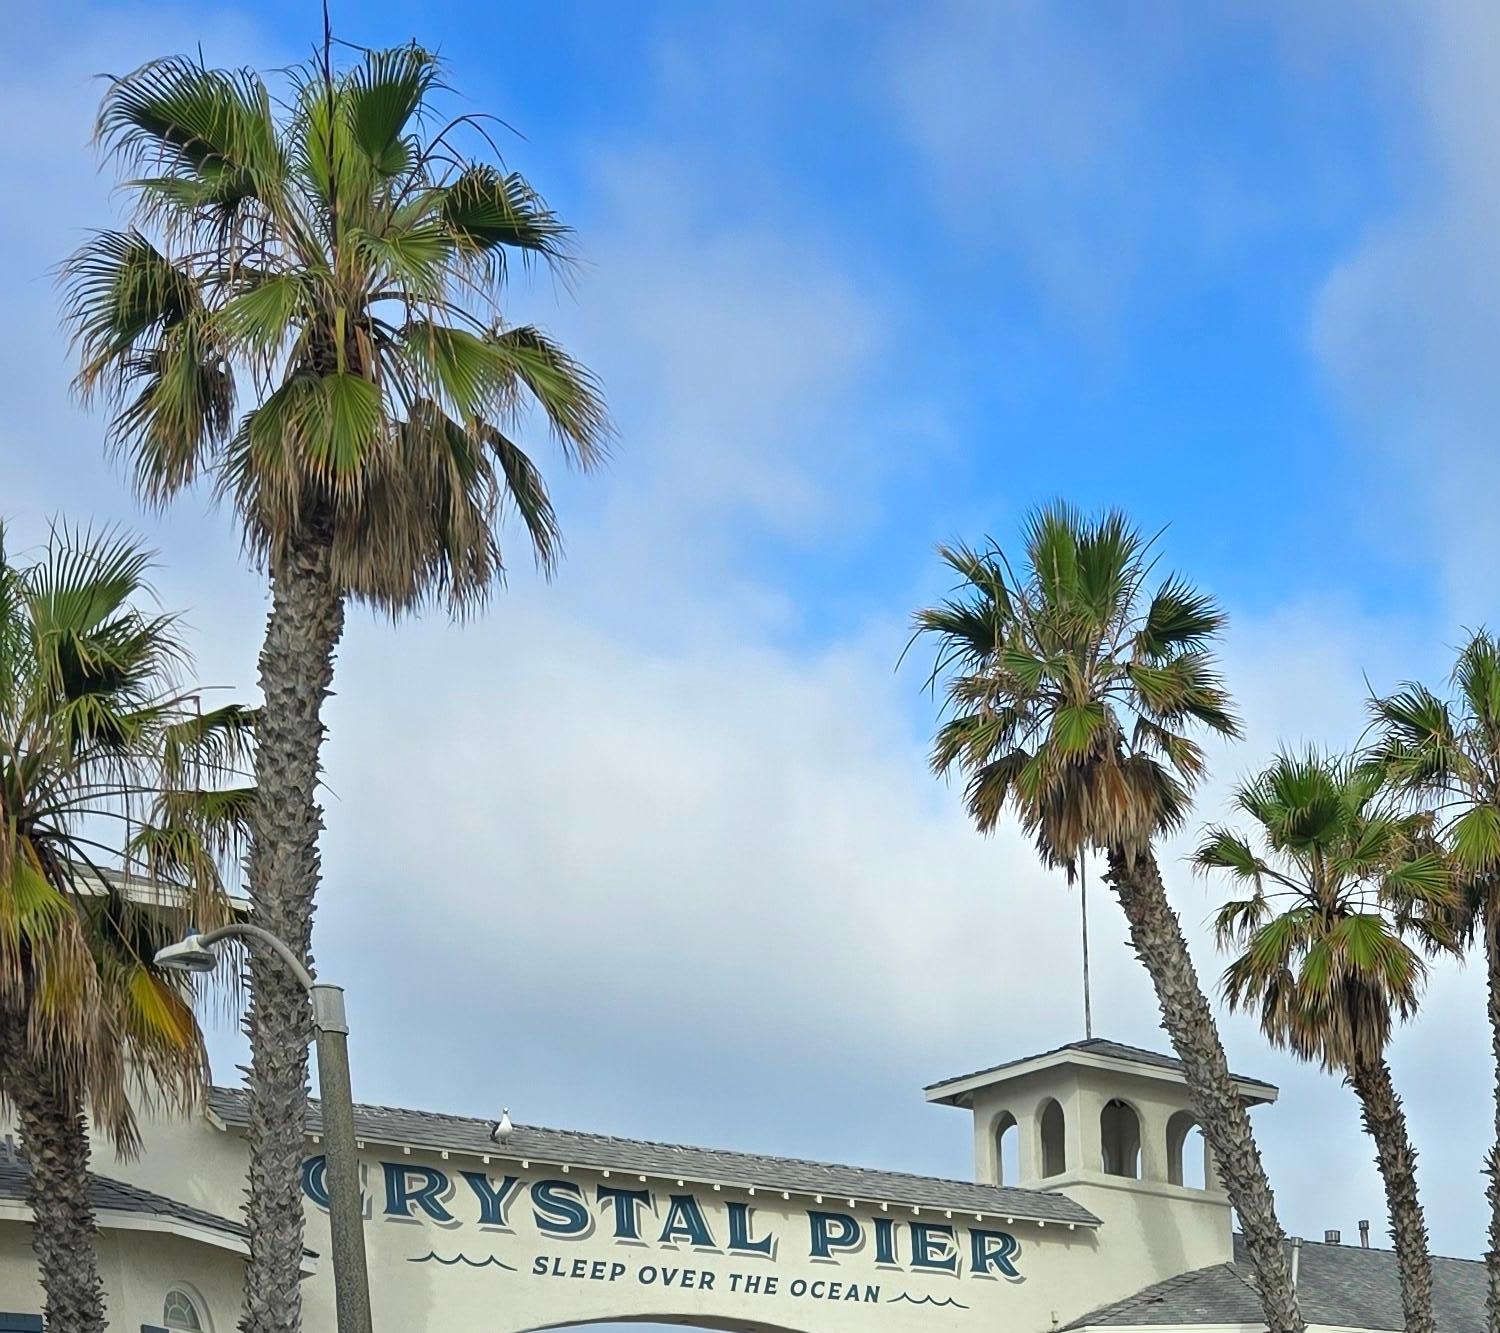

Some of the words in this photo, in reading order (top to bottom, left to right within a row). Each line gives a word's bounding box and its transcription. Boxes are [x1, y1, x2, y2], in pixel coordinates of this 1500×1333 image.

[807, 1209, 1024, 1279] PIER
[532, 1256, 627, 1282] SLEEP
[638, 1265, 717, 1290] OVER
[729, 1273, 779, 1295] THE
[790, 1279, 881, 1303] OCEAN
